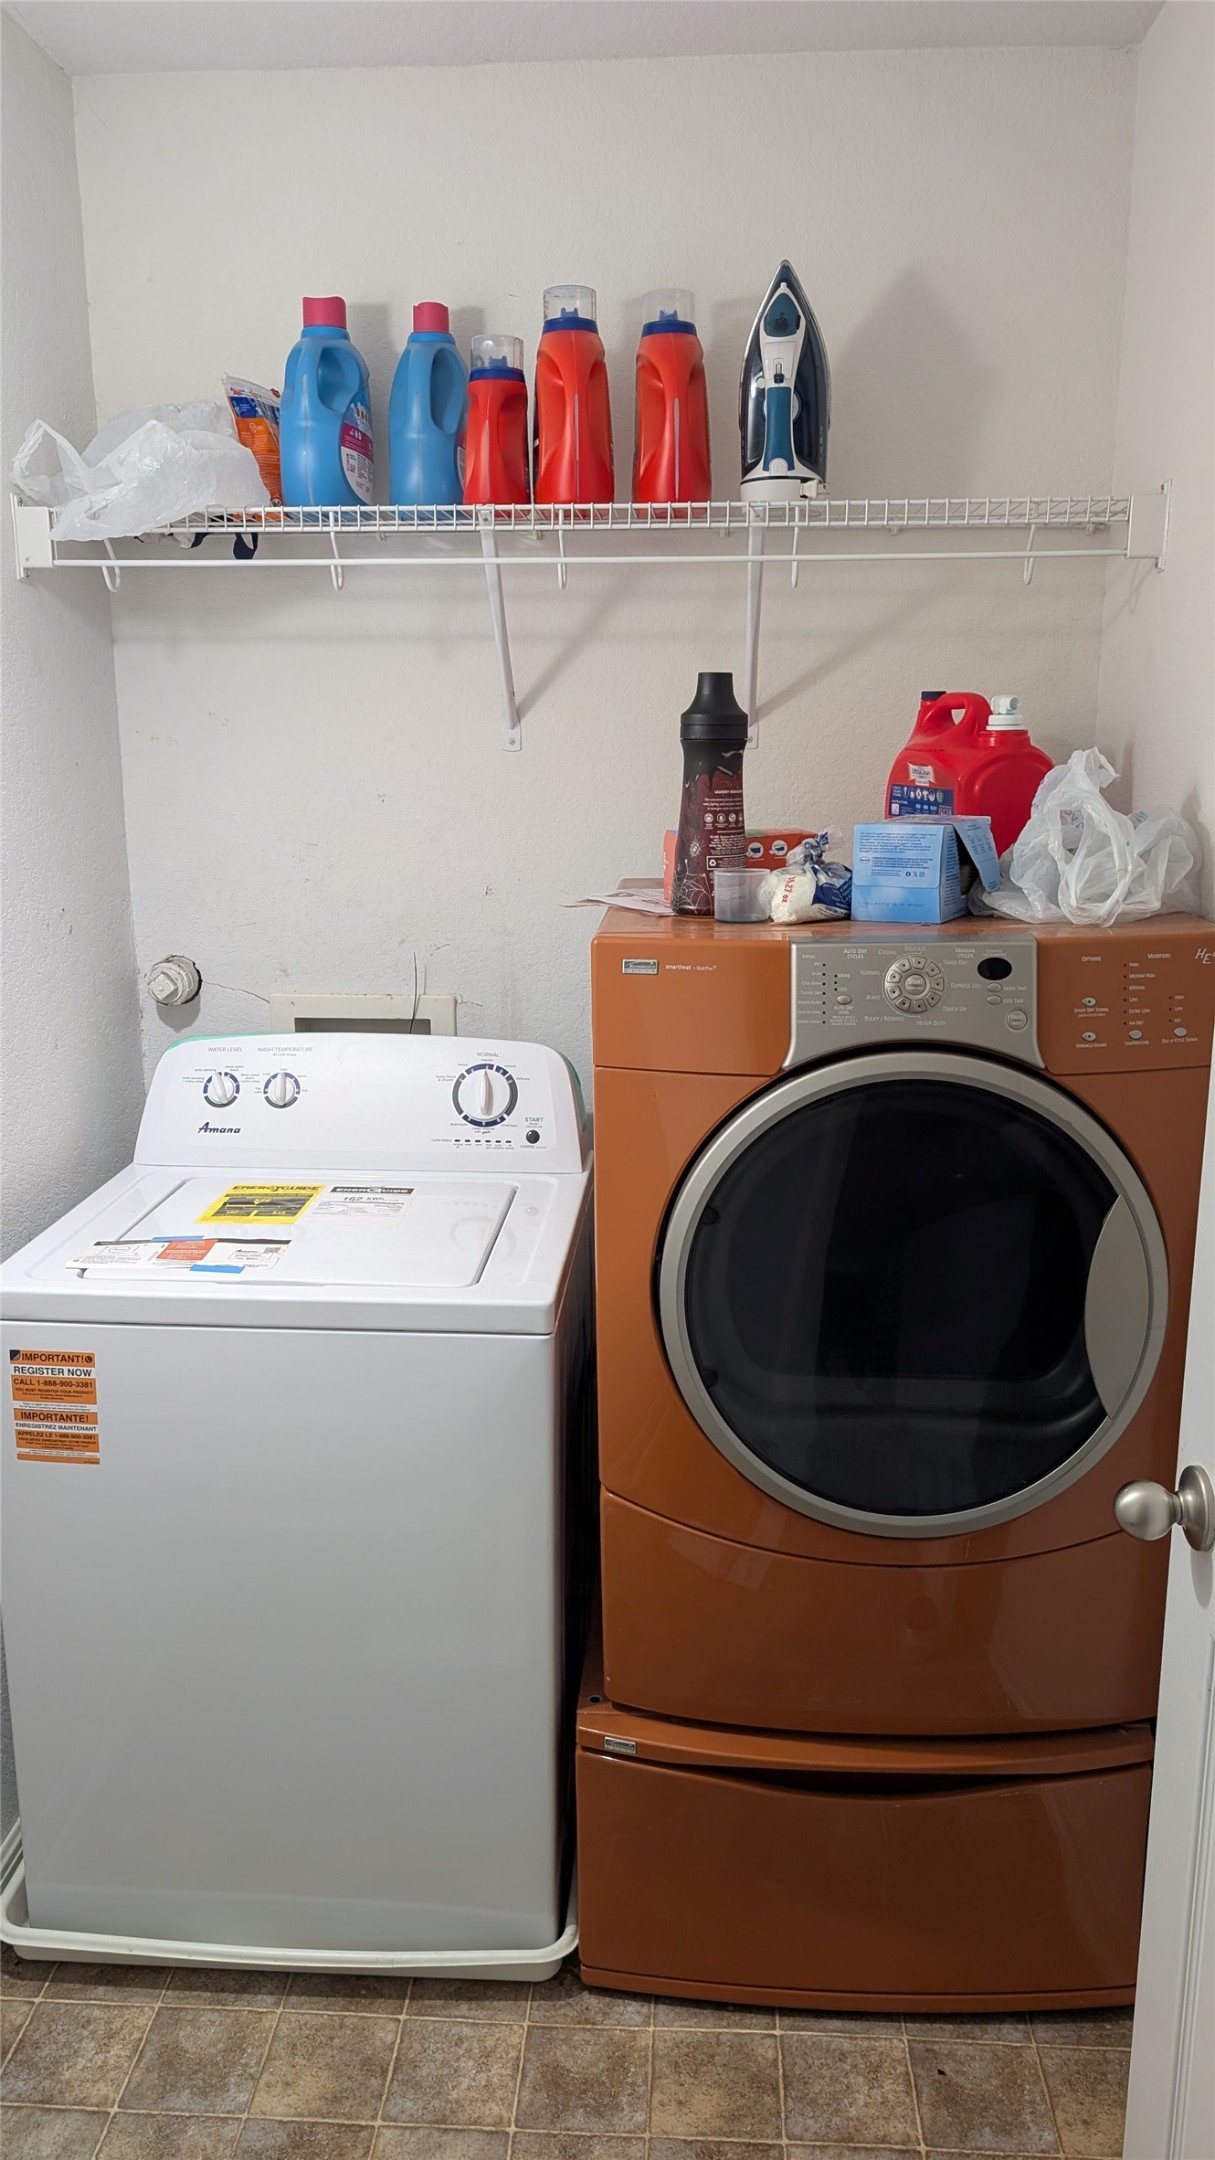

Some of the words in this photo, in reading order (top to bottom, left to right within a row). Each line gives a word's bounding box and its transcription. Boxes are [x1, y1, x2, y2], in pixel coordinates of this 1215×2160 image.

[198, 1122, 241, 1133] Amana
[22, 1353, 84, 1363] IMPORTANT!
[14, 1366, 64, 1376] REGISTER
[68, 1369, 92, 1377] NOW
[14, 1378, 34, 1386] CALL
[38, 1380, 93, 1388] 1-888-900-3381
[21, 1412, 89, 1423] IMPORTANTE!
[16, 1422, 57, 1430] ENREGISTREZ
